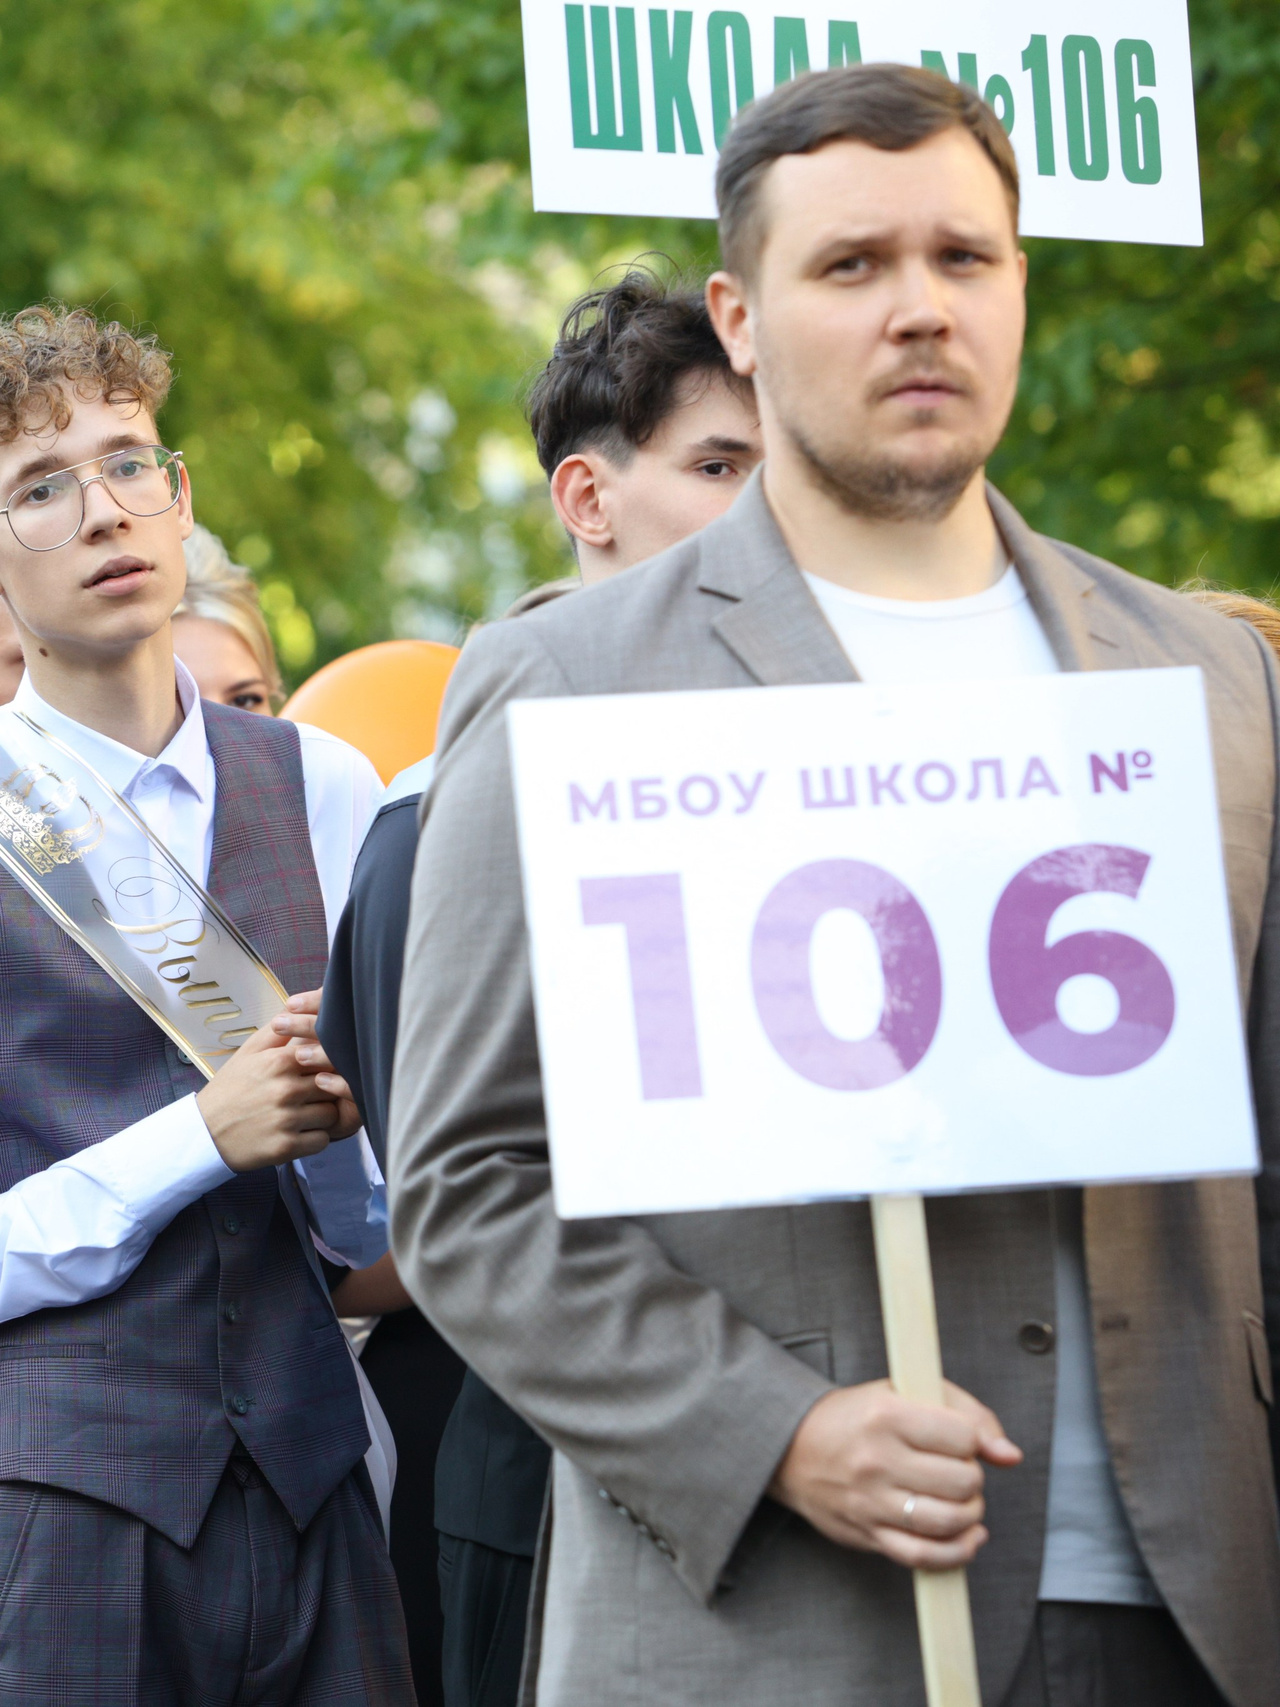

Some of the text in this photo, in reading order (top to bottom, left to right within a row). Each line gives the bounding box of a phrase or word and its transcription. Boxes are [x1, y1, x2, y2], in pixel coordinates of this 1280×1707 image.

[568, 749, 1156, 823] МБОУ ШКОЛА №
[578, 842, 1177, 1102] 106
